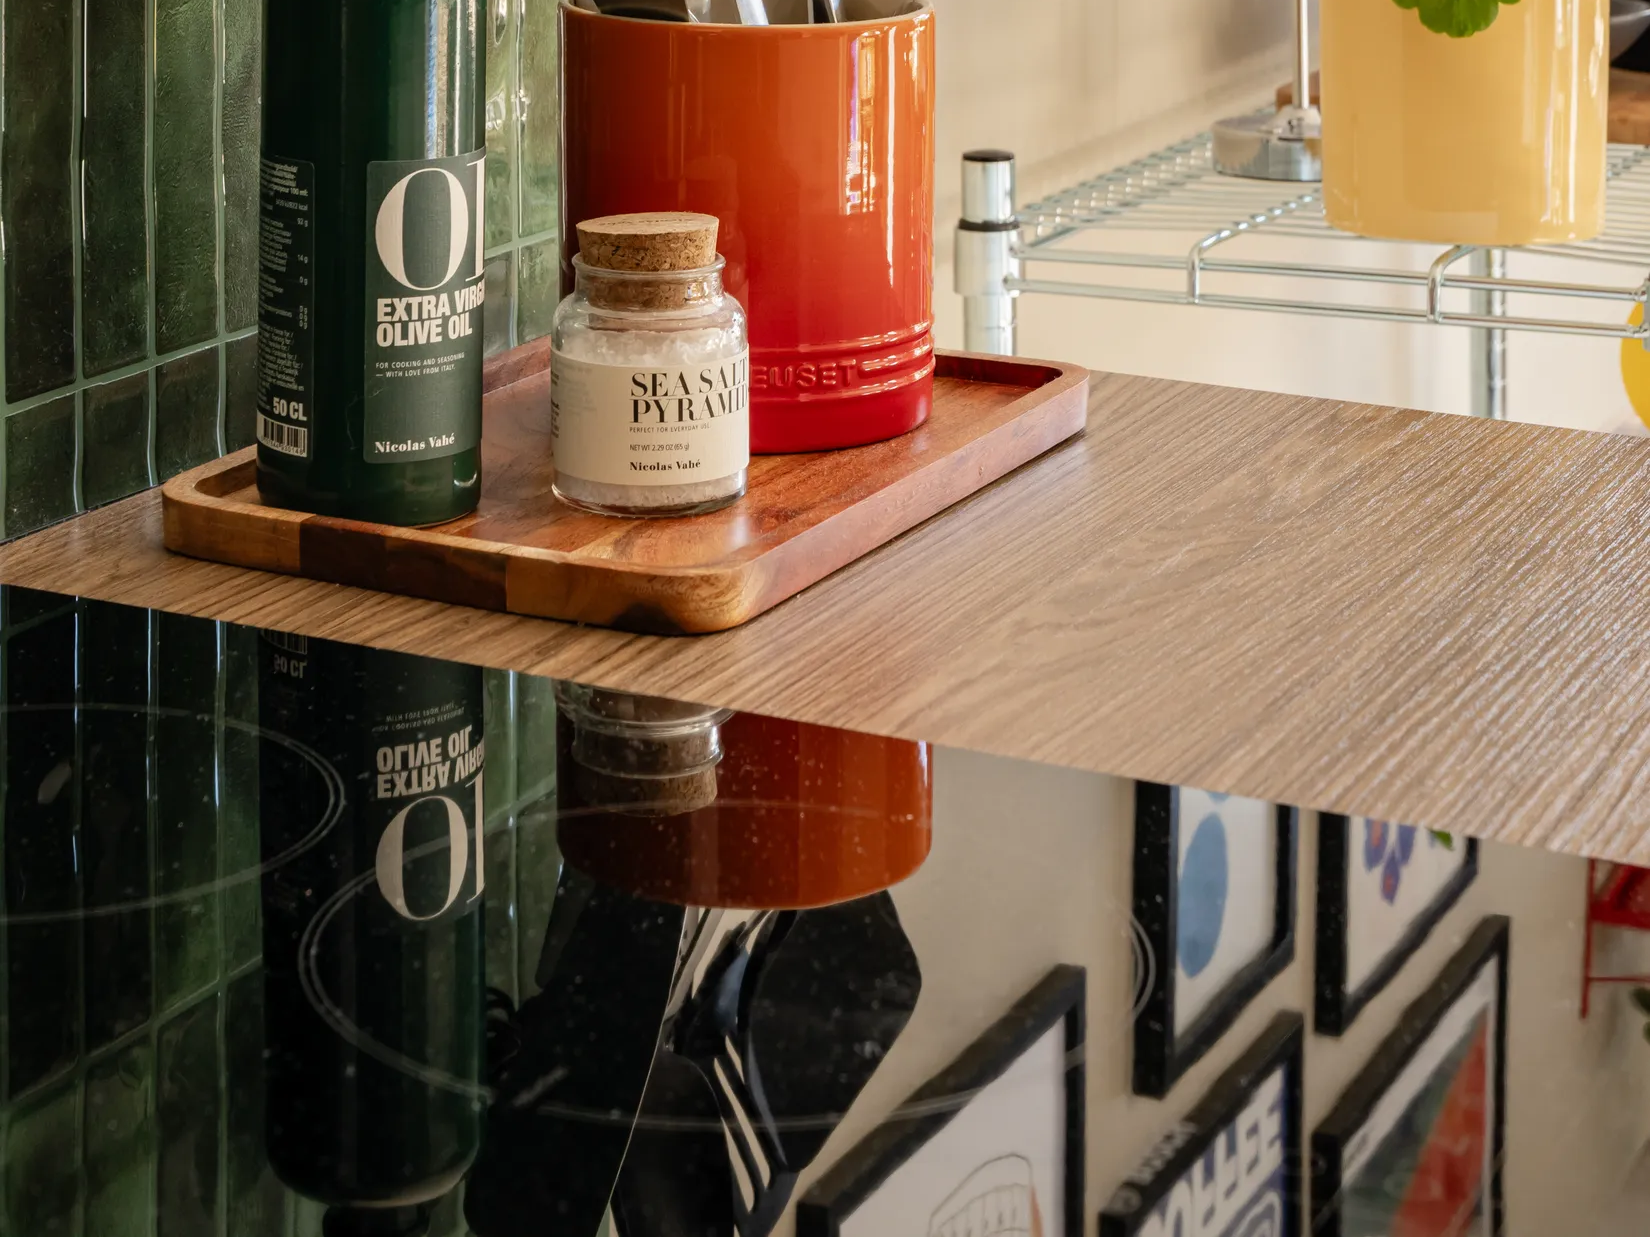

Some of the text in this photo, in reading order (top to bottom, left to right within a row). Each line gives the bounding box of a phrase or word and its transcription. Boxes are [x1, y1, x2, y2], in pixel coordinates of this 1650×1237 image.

[376, 294, 450, 323] EXTRA
[376, 311, 473, 348] OLIVE OIL
[375, 351, 465, 370] FOR COOKING AND SEASONING
[385, 370, 403, 378] WITH
[405, 368, 421, 377] LOVE
[423, 366, 440, 375] FROM
[630, 370, 696, 398] SEA
[698, 356, 748, 394] SALT
[273, 396, 308, 421] 50 CL
[670, 425, 699, 433] EVERYDAY
[375, 433, 455, 454] Nicolas Vahé
[651, 443, 665, 452] 2.29
[665, 443, 674, 451] OZ
[629, 458, 701, 472] Nicolas Vahé
